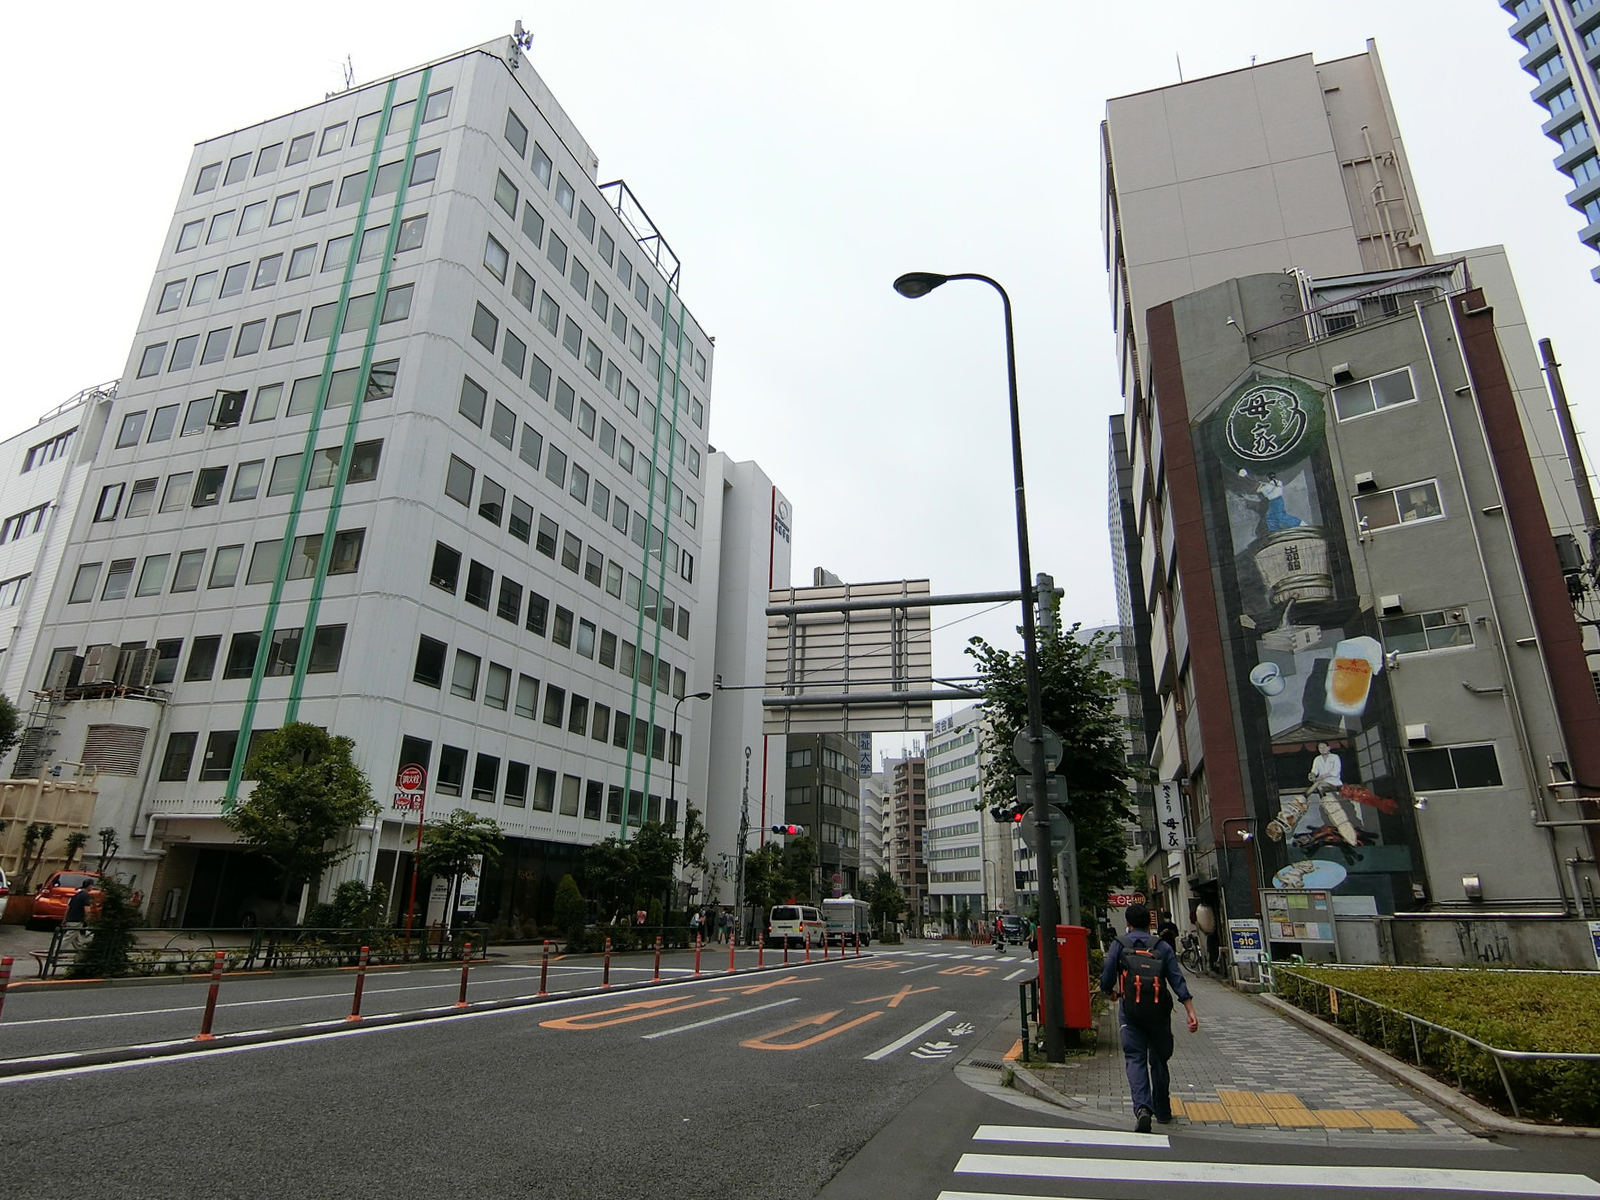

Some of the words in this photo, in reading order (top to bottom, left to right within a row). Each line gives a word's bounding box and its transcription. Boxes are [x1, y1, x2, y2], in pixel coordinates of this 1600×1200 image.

[1238, 393, 1277, 455] 母家
[1162, 817, 1179, 846] 母家
[1238, 937, 1254, 946] 910
